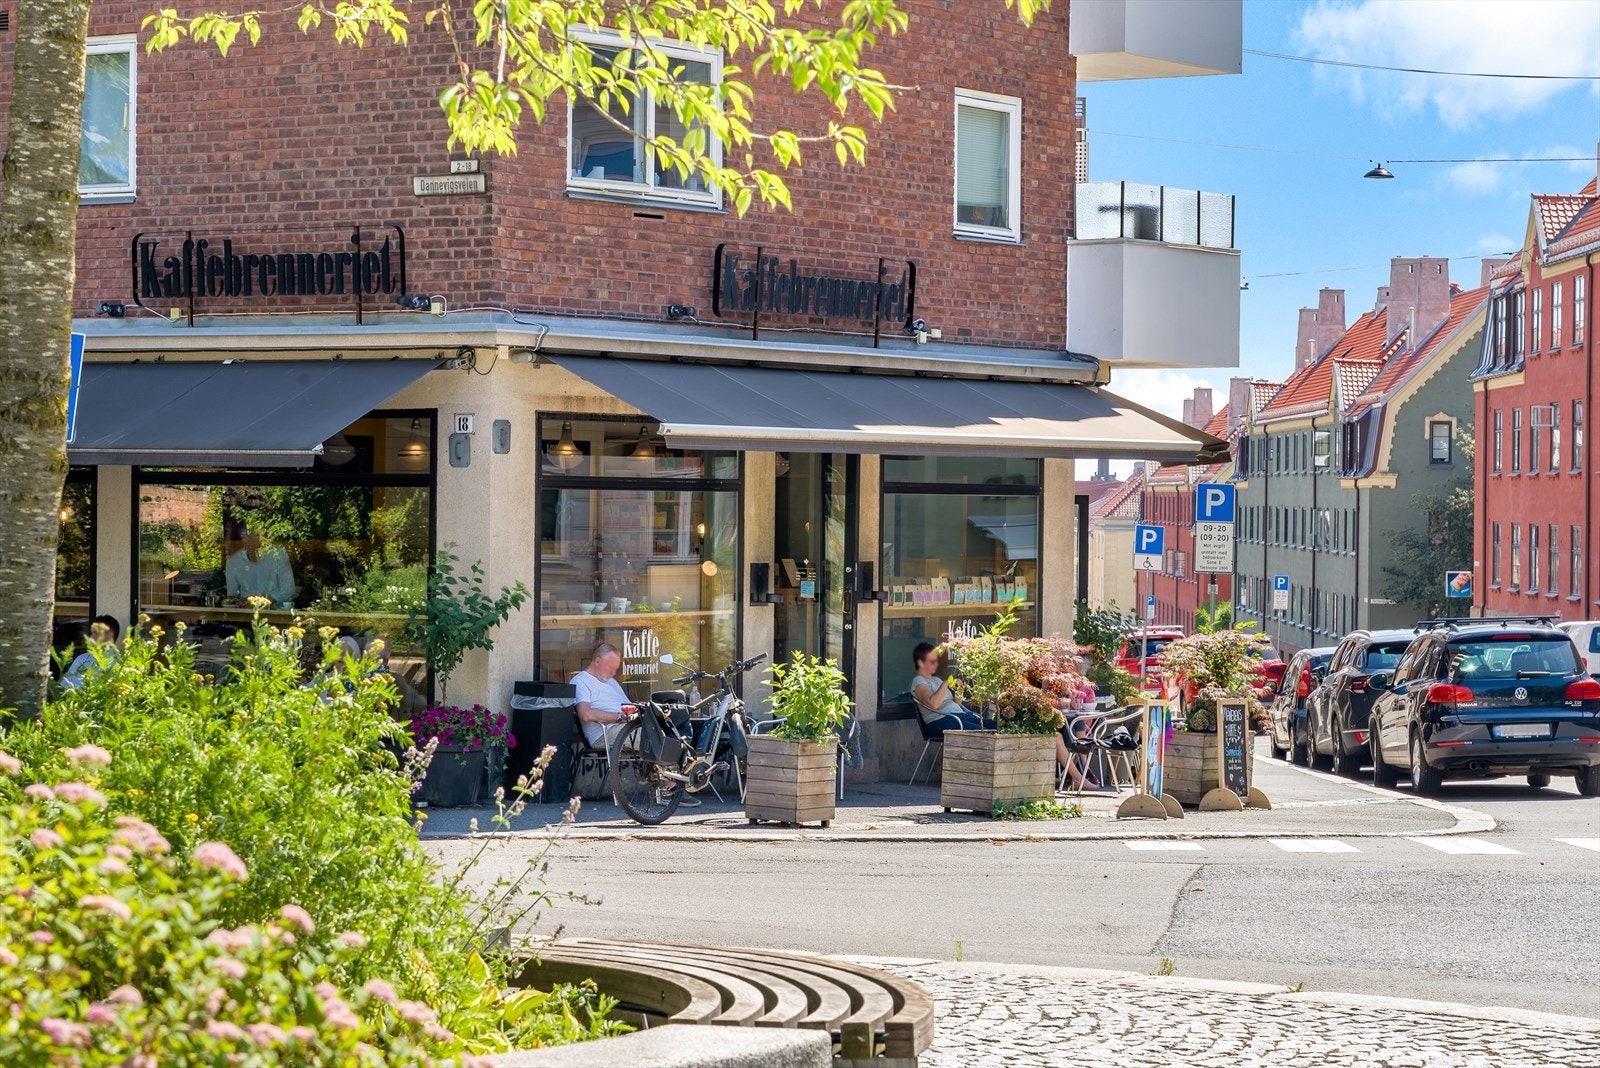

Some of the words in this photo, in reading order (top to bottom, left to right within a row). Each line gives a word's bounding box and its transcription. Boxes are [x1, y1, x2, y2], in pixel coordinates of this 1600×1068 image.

[420, 179, 478, 193] Dannevigsveien
[140, 234, 396, 298] Kaffebrenneriet
[721, 254, 909, 322] Kaffebrenneriet
[458, 417, 469, 431] 18
[1205, 488, 1226, 517] P
[1142, 529, 1157, 551] P
[1277, 577, 1286, 589] P
[622, 628, 660, 658] Kaffe
[622, 660, 659, 675] brenneriet
